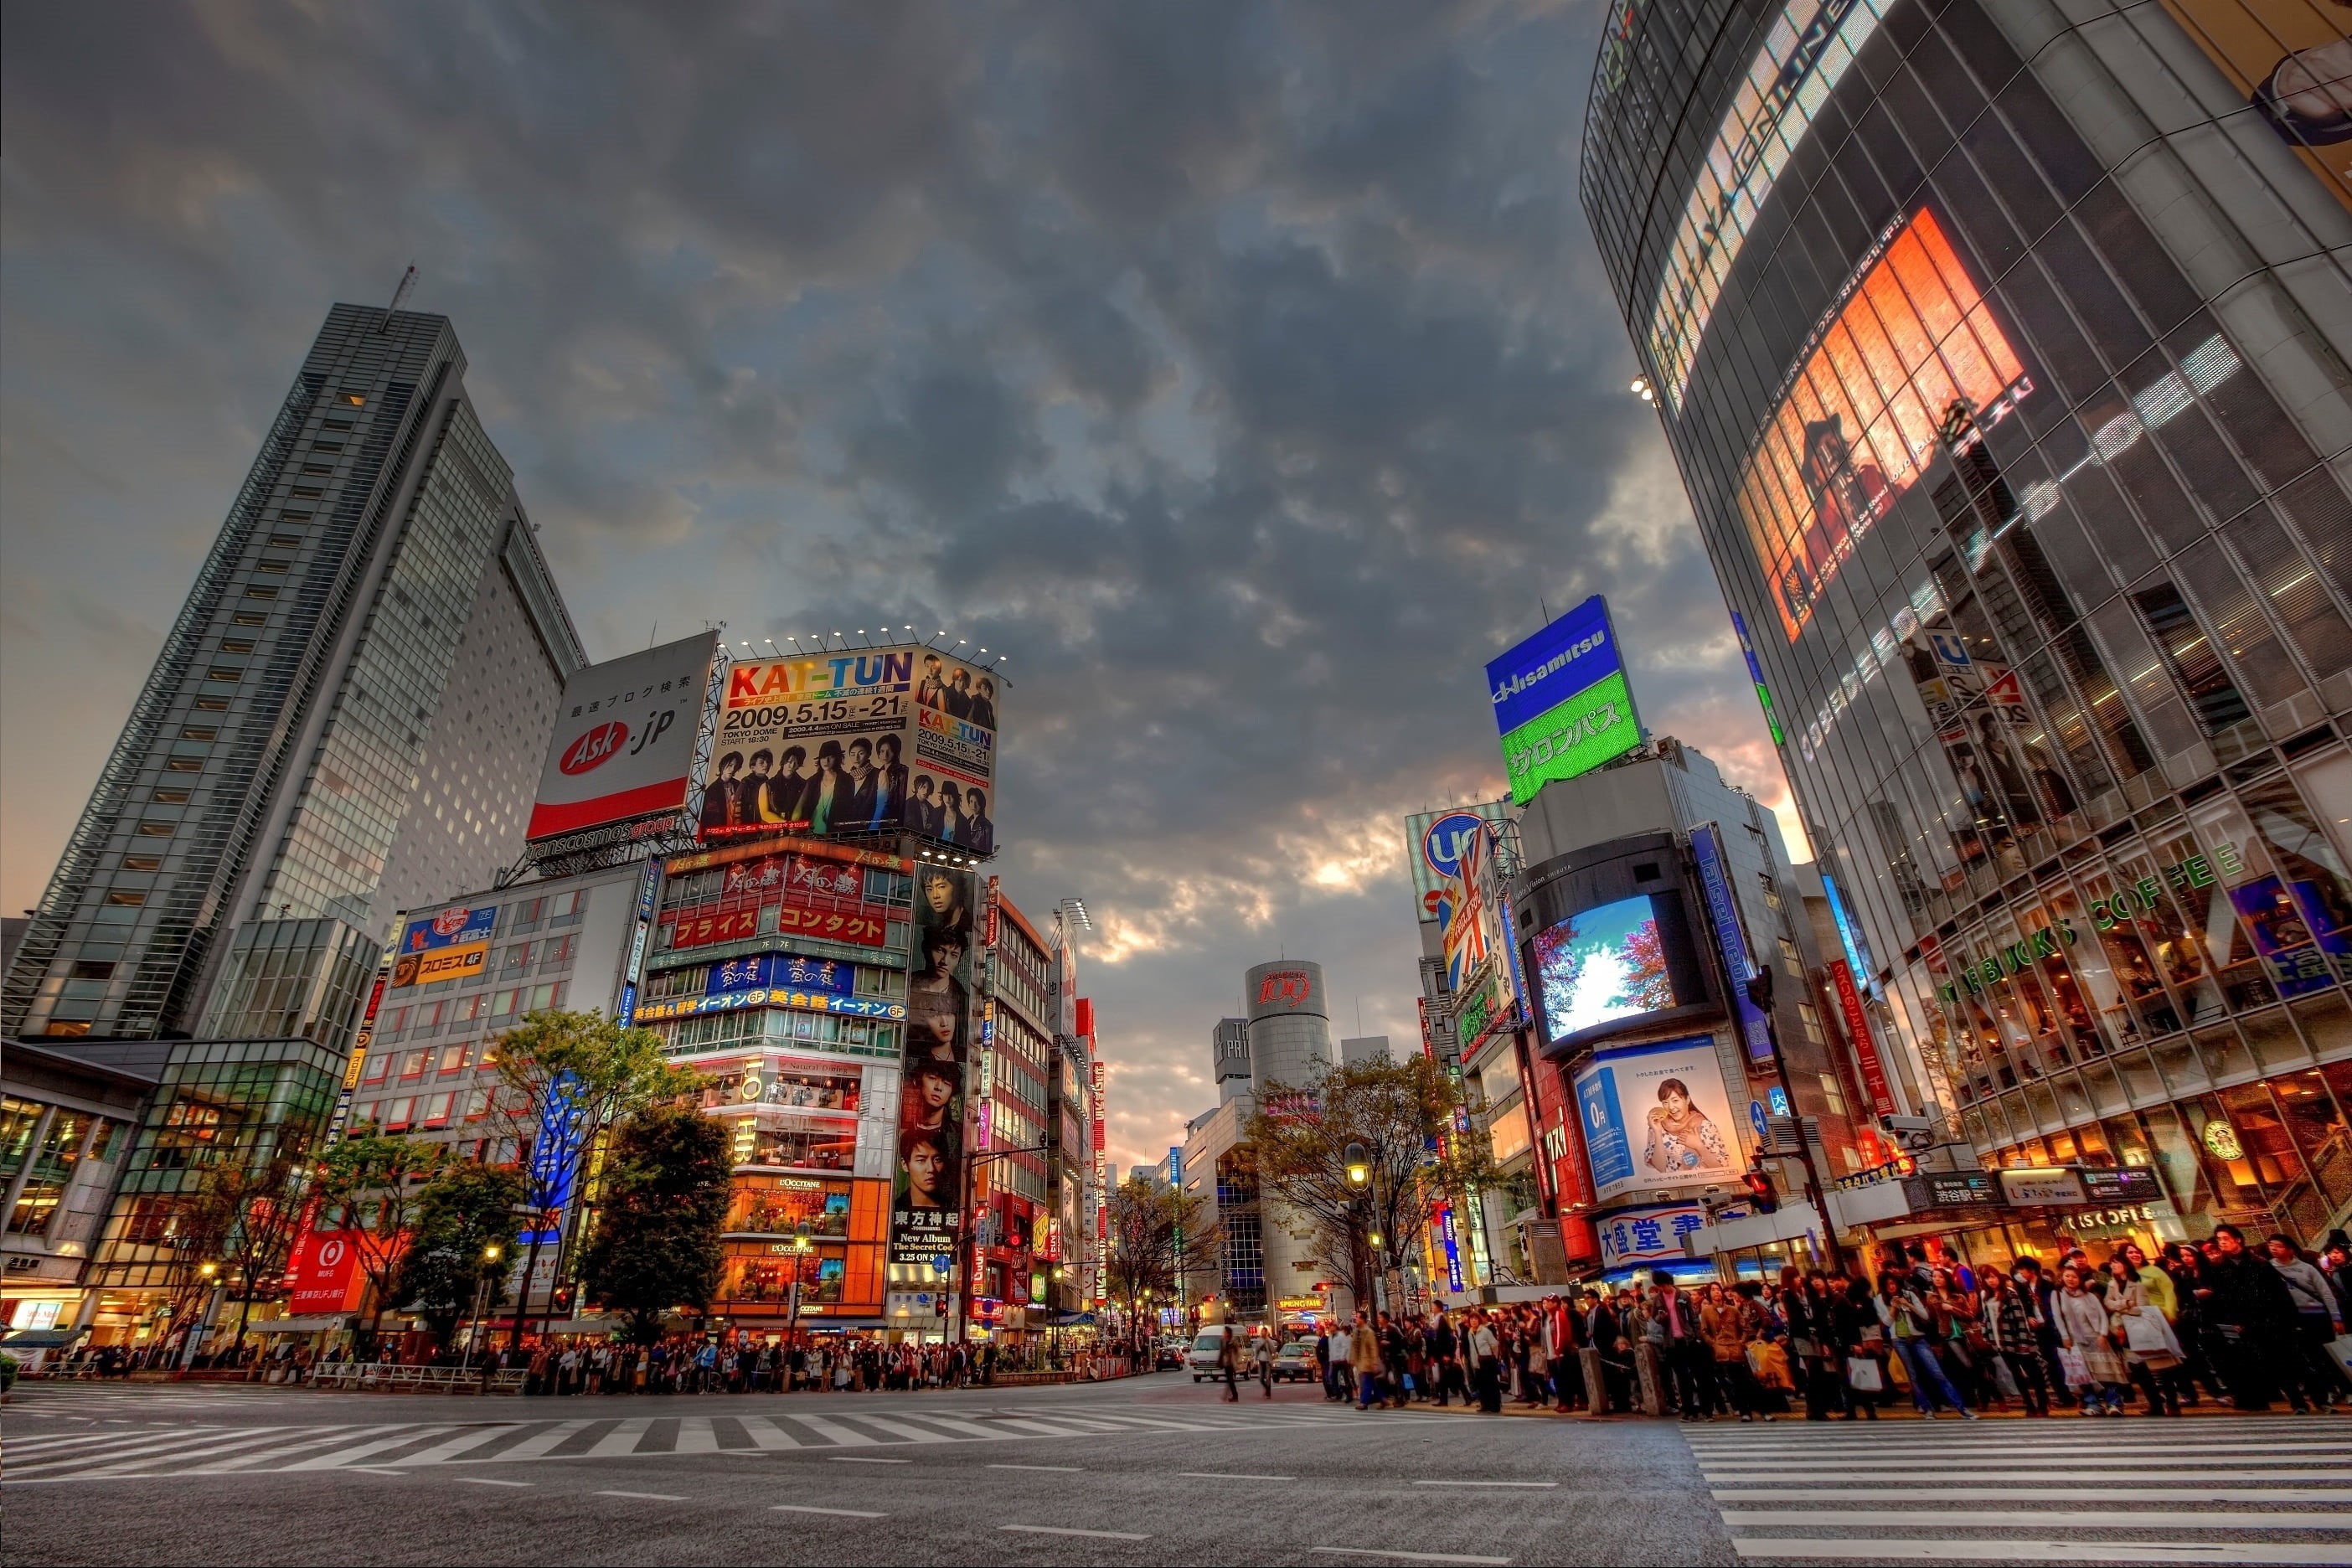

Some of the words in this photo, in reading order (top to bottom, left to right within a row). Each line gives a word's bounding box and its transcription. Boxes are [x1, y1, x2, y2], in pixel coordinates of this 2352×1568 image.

[730, 652, 912, 699] KAT-TUN
[1492, 629, 1605, 704] Hisamitsu
[571, 676, 690, 718] 最速ブログ検索
[724, 700, 848, 730] 2009.5.15
[723, 730, 750, 739] TOKYO
[753, 728, 777, 736] DOME
[919, 708, 992, 747] KAT-TUN
[1510, 700, 1621, 776] サロンパス
[721, 738, 745, 746] START
[748, 735, 769, 744] 18:30
[918, 729, 967, 752] 2009.5.15
[918, 738, 936, 748] TOKYO
[939, 745, 954, 754] DOME
[525, 823, 631, 860] transcosmos
[632, 817, 674, 837] group
[1526, 876, 1545, 892] Vision
[1547, 864, 1571, 878] SHIBUYA
[480, 910, 492, 920] 7F
[677, 912, 756, 942] プライス
[781, 909, 883, 938] コンタクト
[1700, 849, 1734, 926] Taisei
[1721, 931, 1749, 997] neon
[761, 941, 770, 949] 7F
[780, 941, 789, 949] 7F
[421, 955, 464, 974] プロミス
[467, 953, 480, 965] 4F
[1257, 977, 1310, 1008] 109
[890, 1007, 903, 1017] 6F
[1834, 963, 1870, 1049] クスリのことなら
[1227, 1040, 1250, 1058] PRI
[790, 1063, 818, 1071] Natural
[822, 1065, 848, 1074] Dining
[1591, 1101, 1606, 1128] 0円
[780, 1179, 820, 1188] L'OCCITANE
[1936, 1190, 1972, 1203] 渋谷駅
[895, 1211, 959, 1226] 東方神起
[1444, 1215, 1453, 1240] MIZUHO
[900, 1234, 920, 1242] New
[922, 1234, 951, 1242] Album
[1306, 1299, 1322, 1308] FAIR
